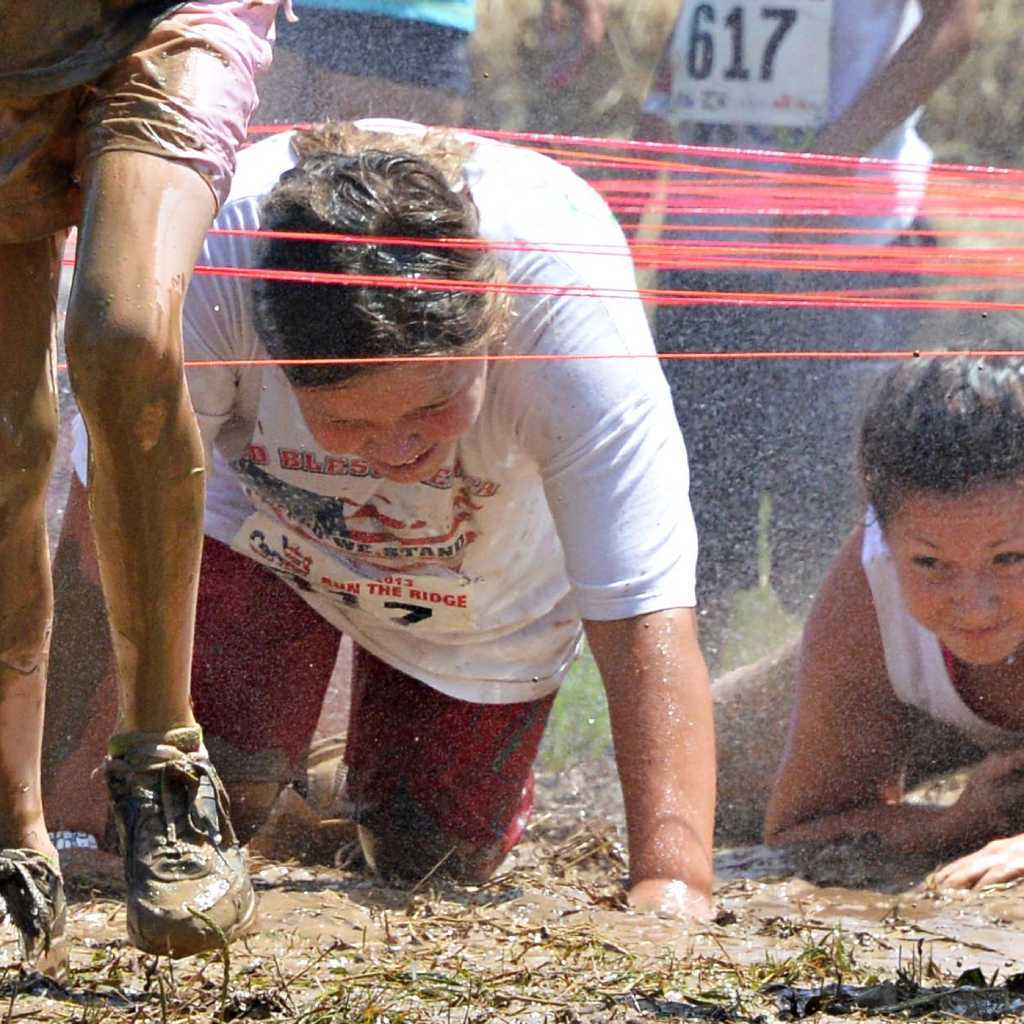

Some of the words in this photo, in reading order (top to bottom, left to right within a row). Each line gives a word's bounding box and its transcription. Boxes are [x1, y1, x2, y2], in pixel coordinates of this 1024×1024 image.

[687, 3, 798, 82] 617
[334, 536, 373, 554] WE
[366, 582, 403, 598] THE
[408, 586, 469, 609] RIDGE
